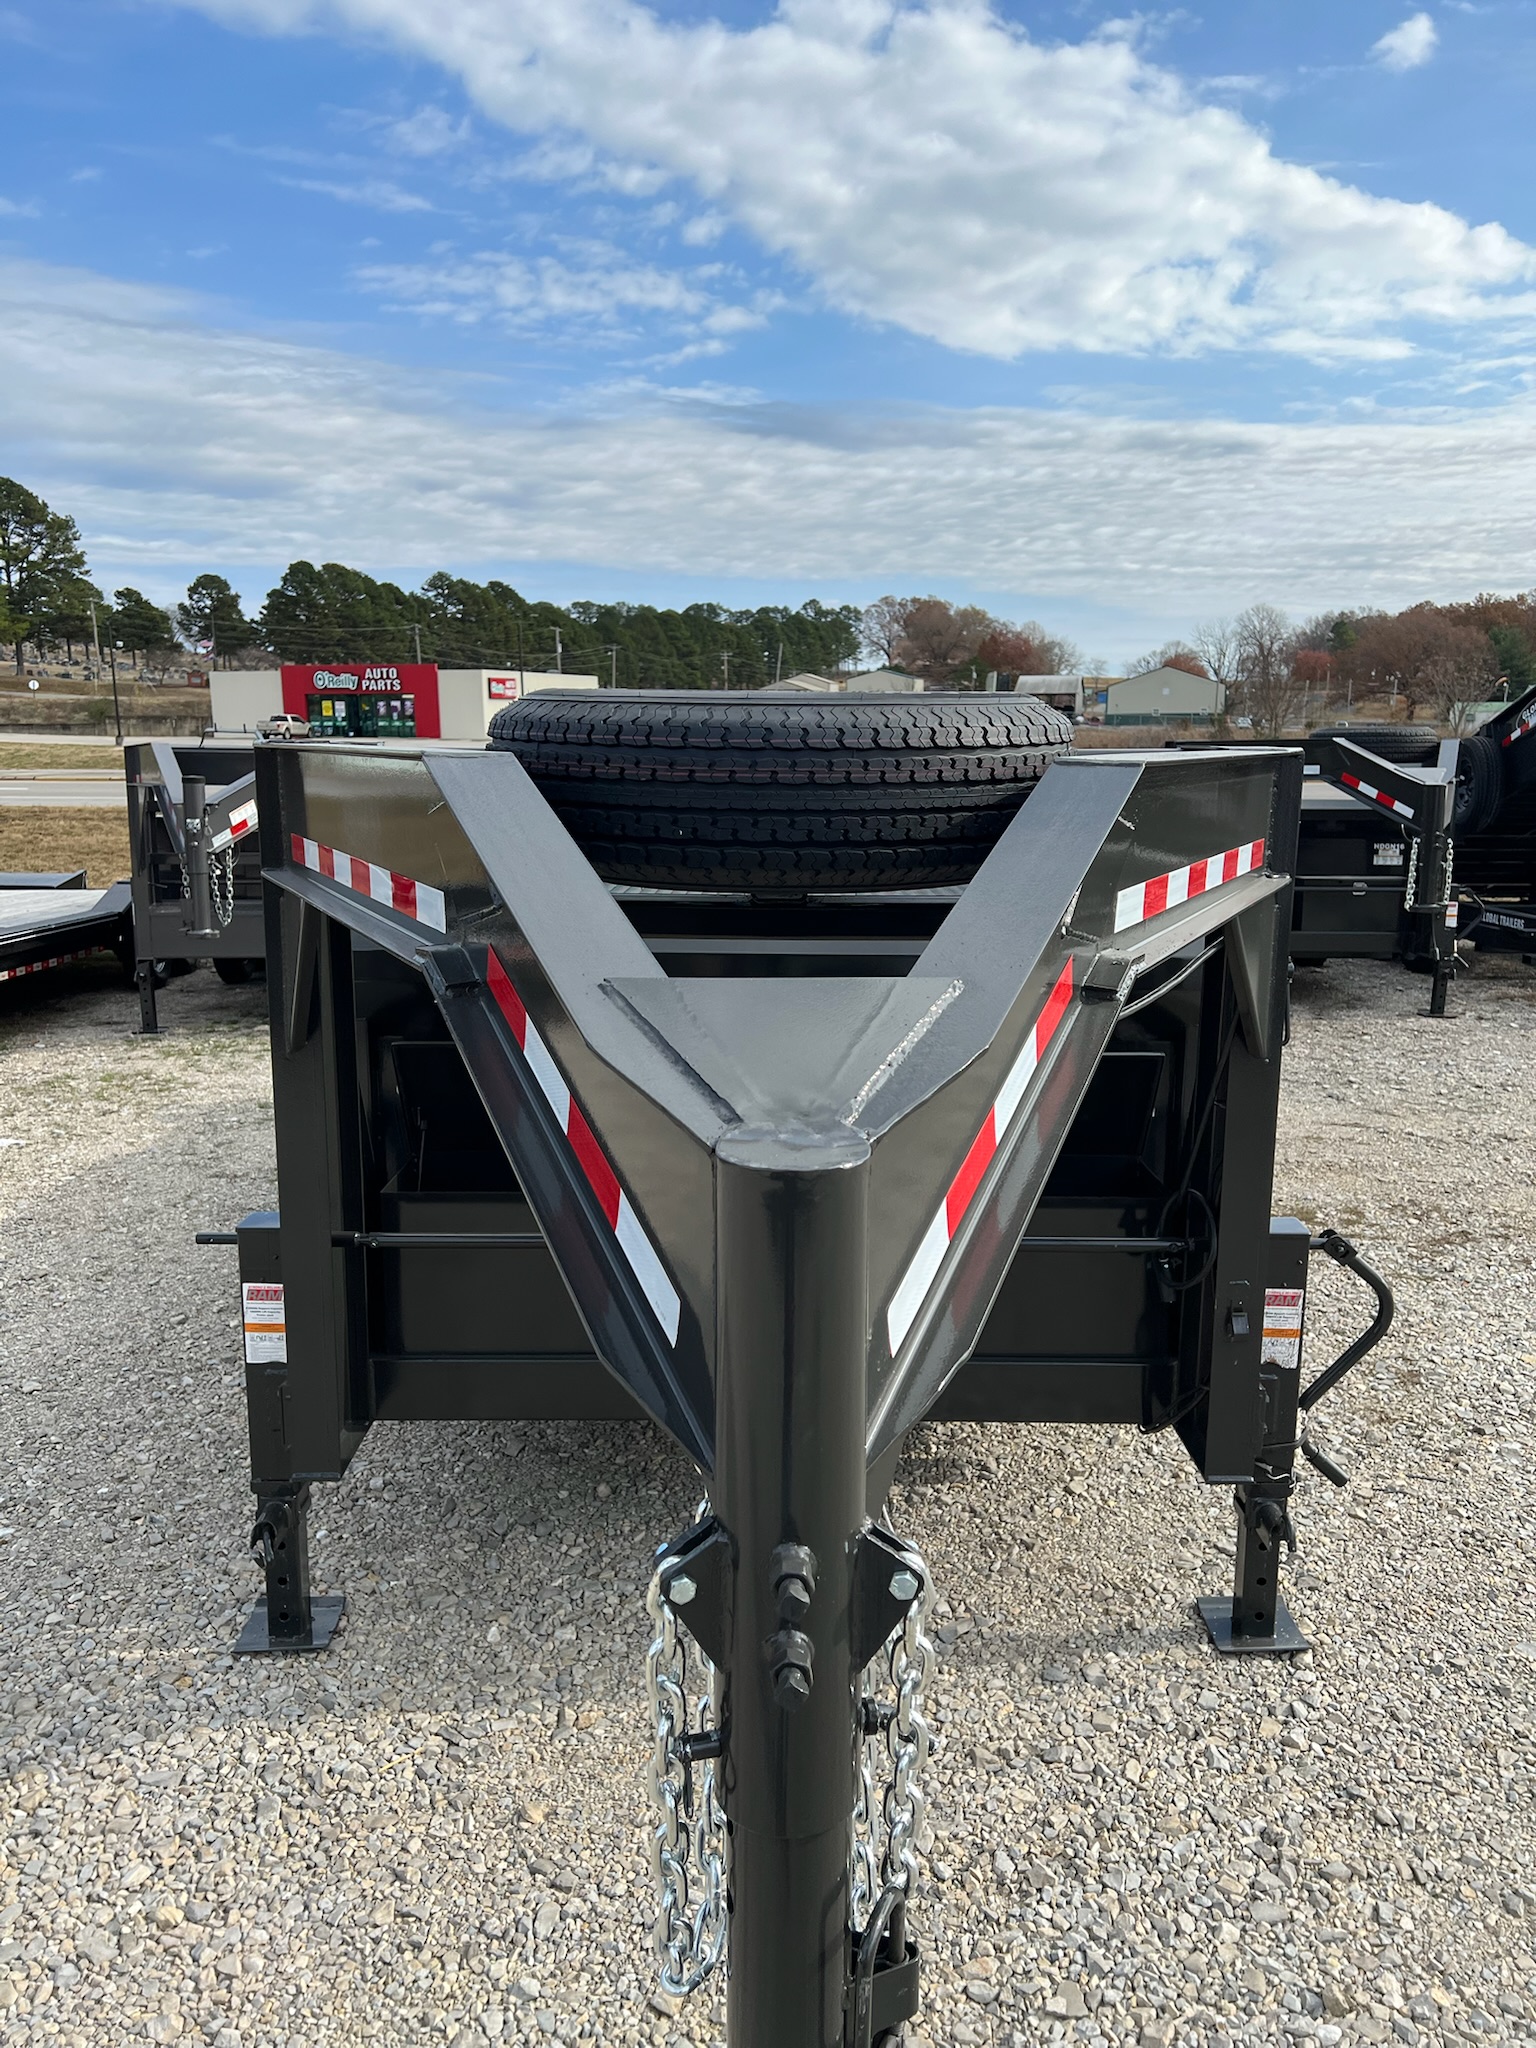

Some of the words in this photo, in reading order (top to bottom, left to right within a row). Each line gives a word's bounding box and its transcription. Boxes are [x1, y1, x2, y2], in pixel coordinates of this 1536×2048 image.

[365, 667, 397, 679] AUTO
[313, 670, 358, 690] O'Reilly
[361, 679, 401, 691] PARTS
[1500, 915, 1525, 929] TRAILERS
[247, 1290, 283, 1301] RAM
[1265, 1295, 1300, 1306] RAM
